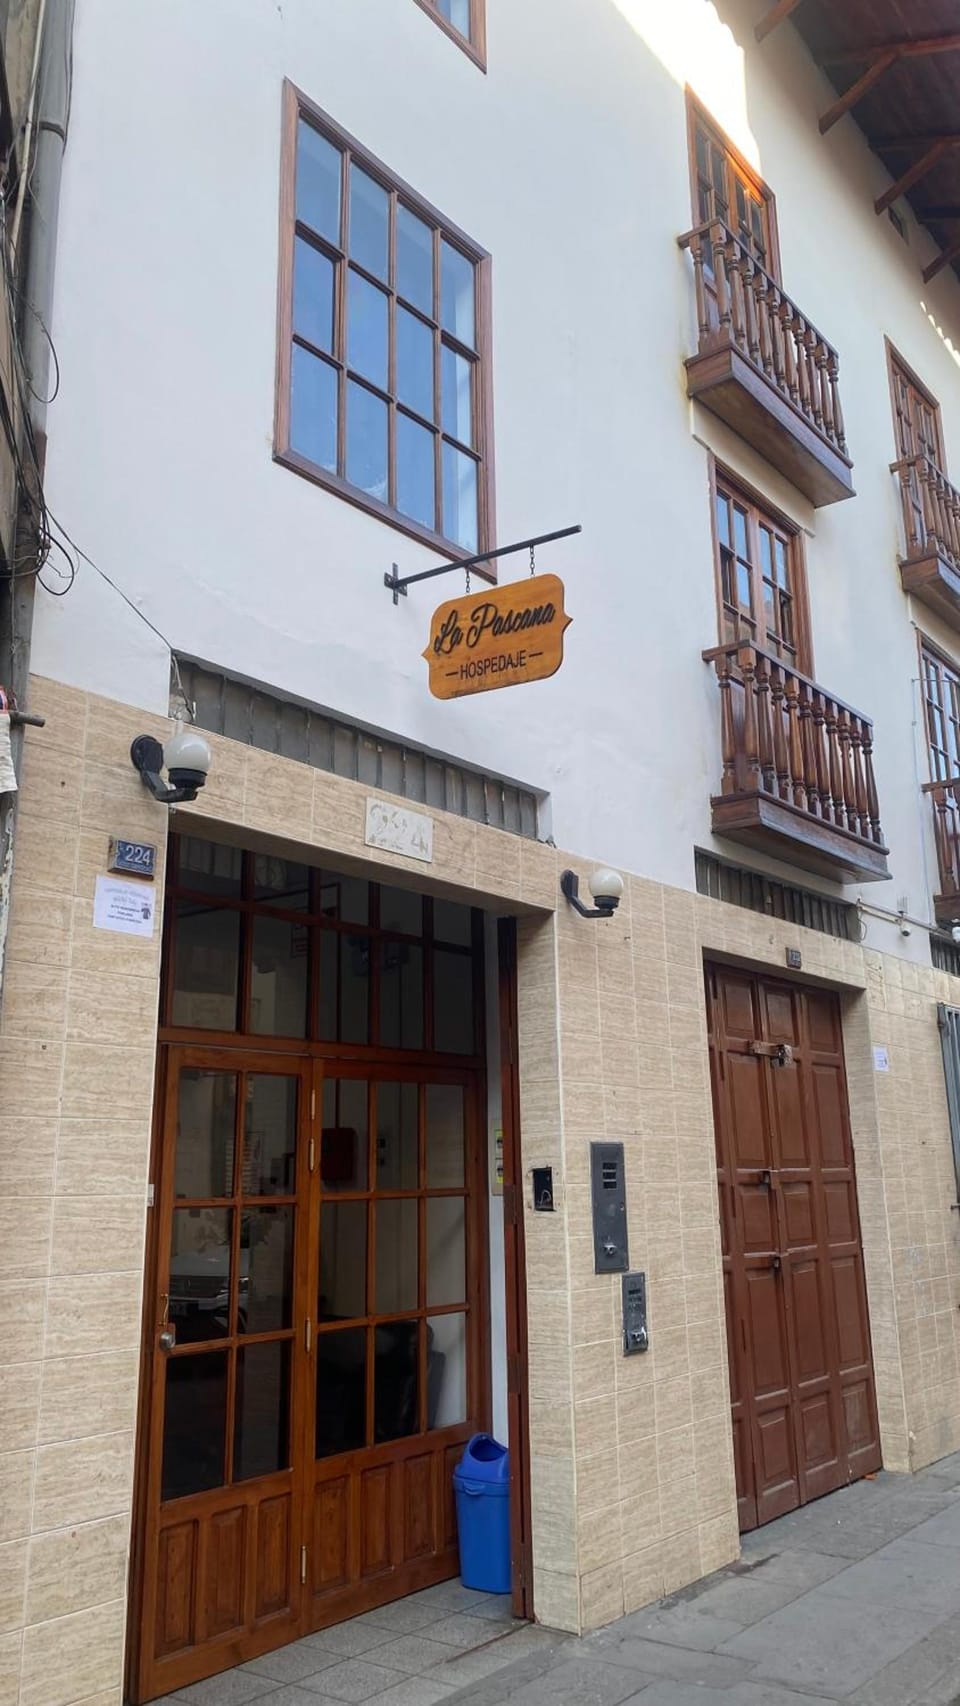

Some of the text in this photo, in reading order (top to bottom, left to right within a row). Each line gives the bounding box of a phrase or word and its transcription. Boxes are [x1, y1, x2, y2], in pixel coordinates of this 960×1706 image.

[433, 603, 556, 656] La Pascana
[460, 650, 527, 680] HOSPEDAJE
[125, 845, 151, 866] 224
